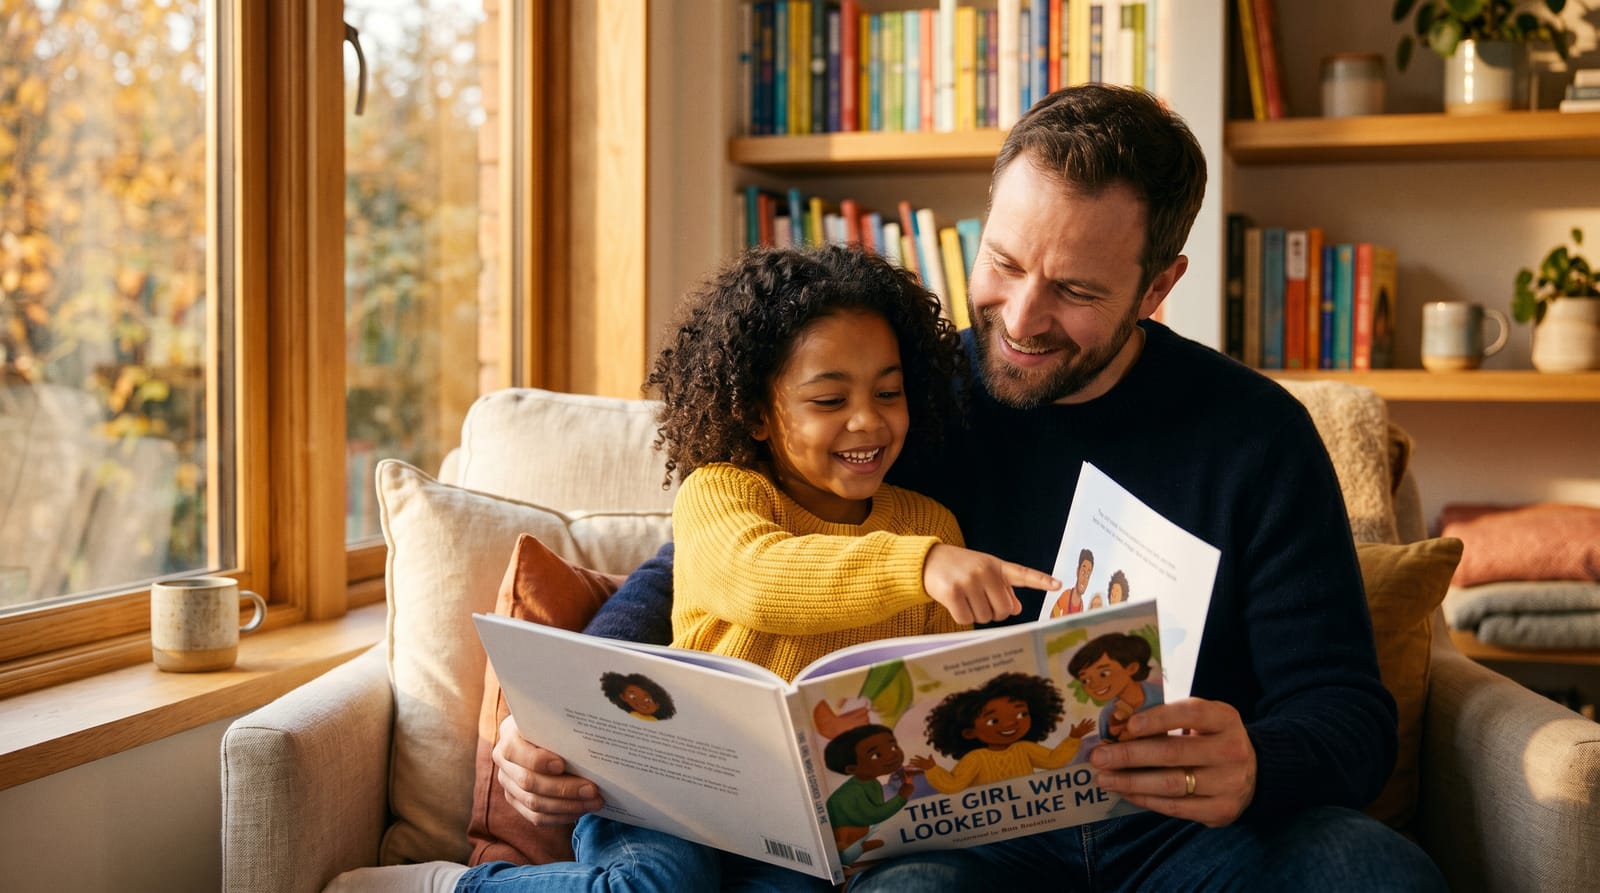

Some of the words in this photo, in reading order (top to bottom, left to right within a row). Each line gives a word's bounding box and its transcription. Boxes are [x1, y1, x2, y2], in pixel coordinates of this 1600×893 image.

[900, 808, 1003, 844] LOOKED
[1011, 794, 1065, 820] LIKE
[1075, 786, 1110, 807] ME
[904, 798, 953, 822] THE
[962, 785, 1021, 810] GIRL
[1029, 769, 1092, 795] WHO
